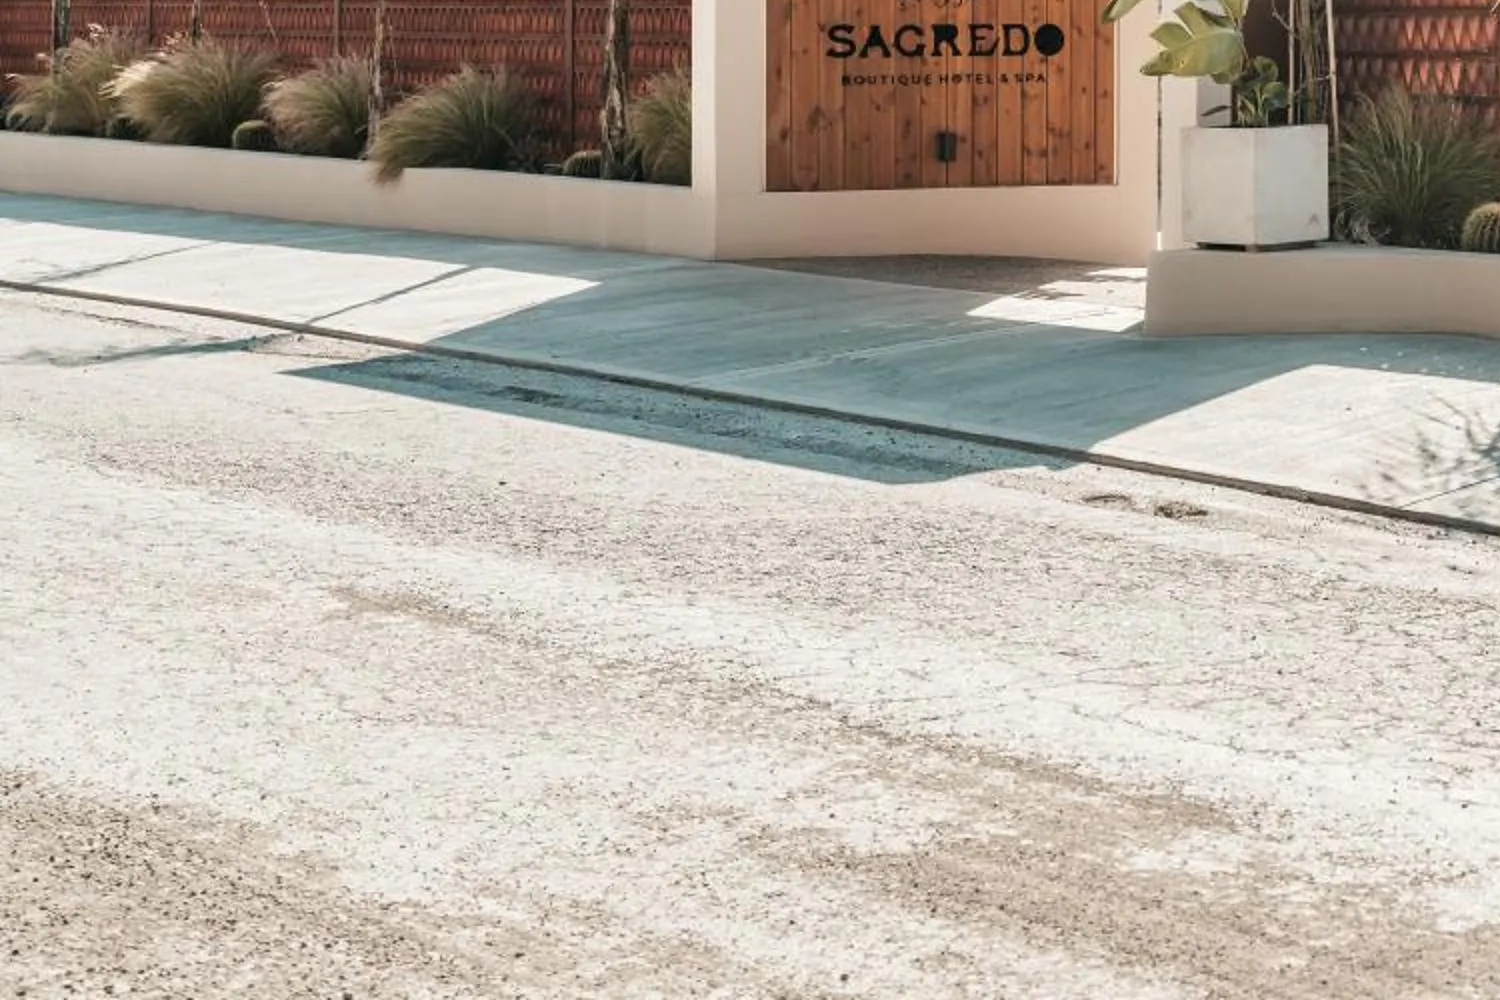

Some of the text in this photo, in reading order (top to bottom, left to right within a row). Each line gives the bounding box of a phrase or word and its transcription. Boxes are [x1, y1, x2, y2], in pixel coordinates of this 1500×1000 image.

[826, 23, 1065, 59] SAGREDO
[841, 73, 1046, 86] BOUTIQUE HOTEL & SPA
